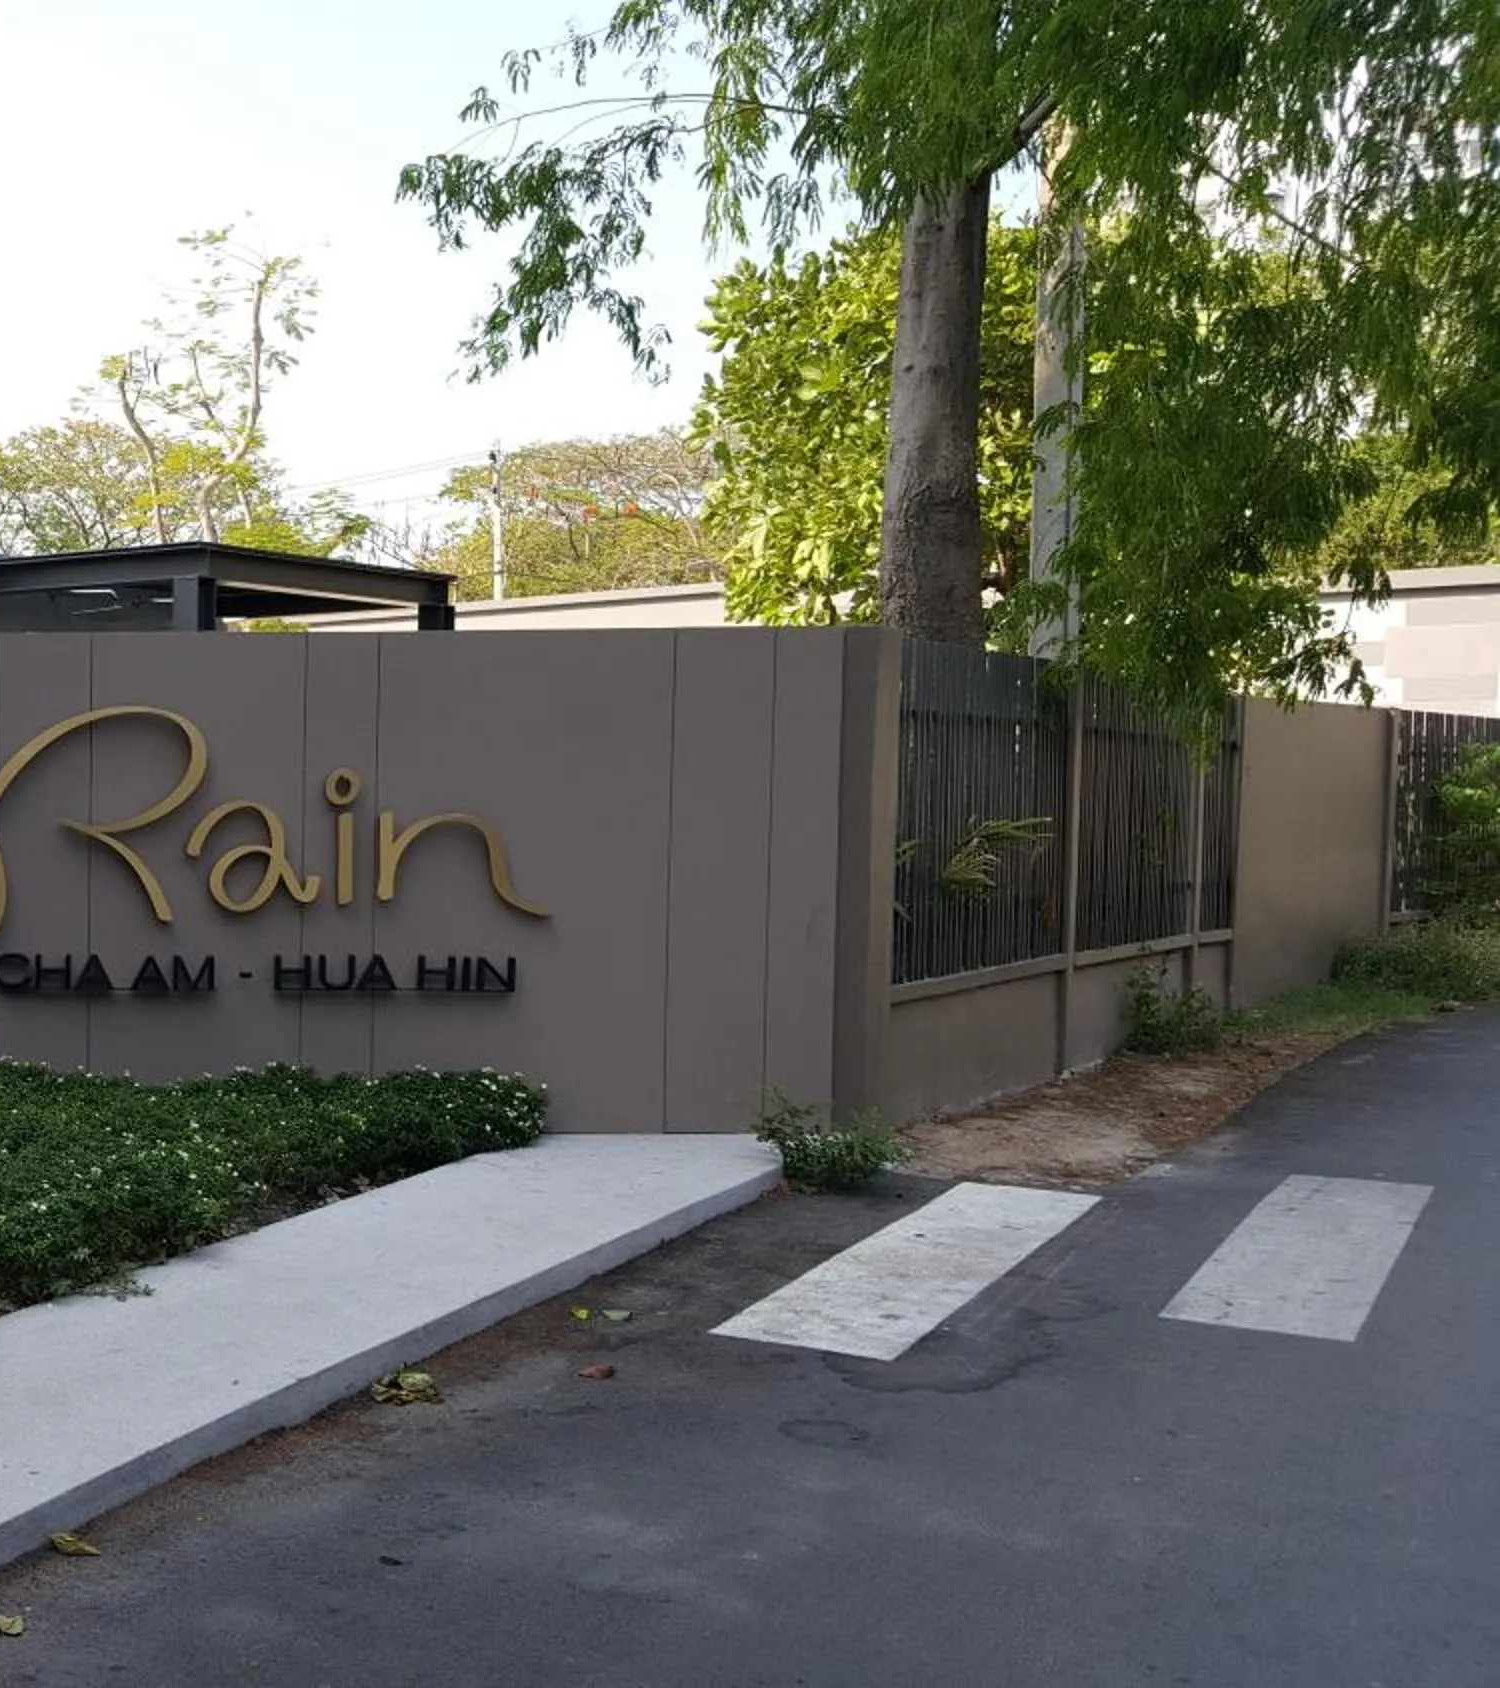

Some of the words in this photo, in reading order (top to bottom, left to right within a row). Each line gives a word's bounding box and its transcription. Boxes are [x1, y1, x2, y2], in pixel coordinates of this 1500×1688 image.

[130, 954, 216, 992] AM
[273, 954, 396, 992] HUA
[417, 955, 516, 993] HIN
